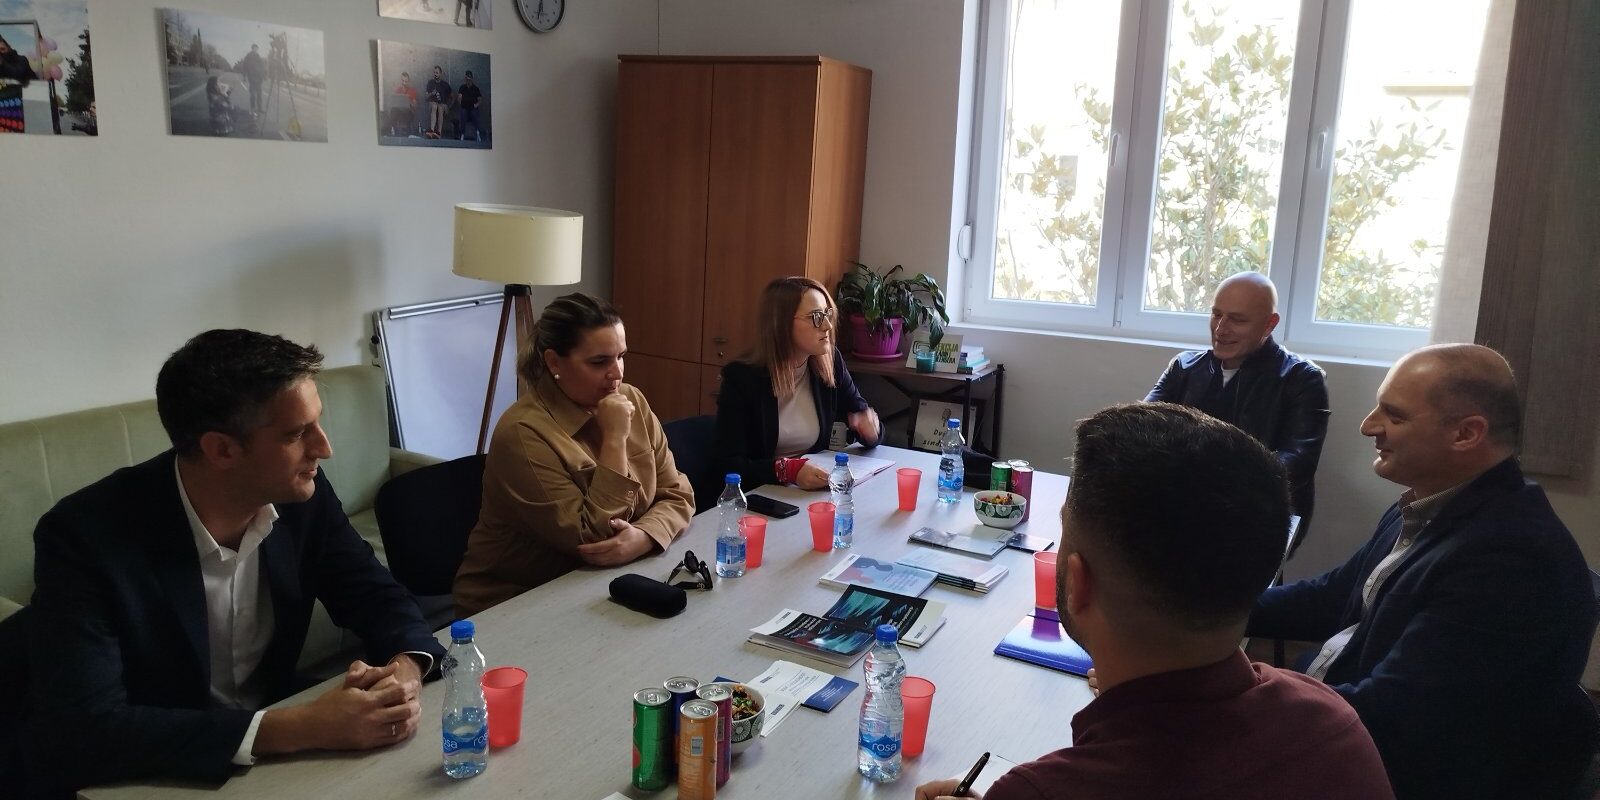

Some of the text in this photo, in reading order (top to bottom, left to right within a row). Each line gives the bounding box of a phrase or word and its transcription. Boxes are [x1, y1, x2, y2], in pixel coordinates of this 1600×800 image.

[922, 440, 942, 448] sind
[443, 738, 458, 749] osa
[871, 742, 897, 752] rosa
